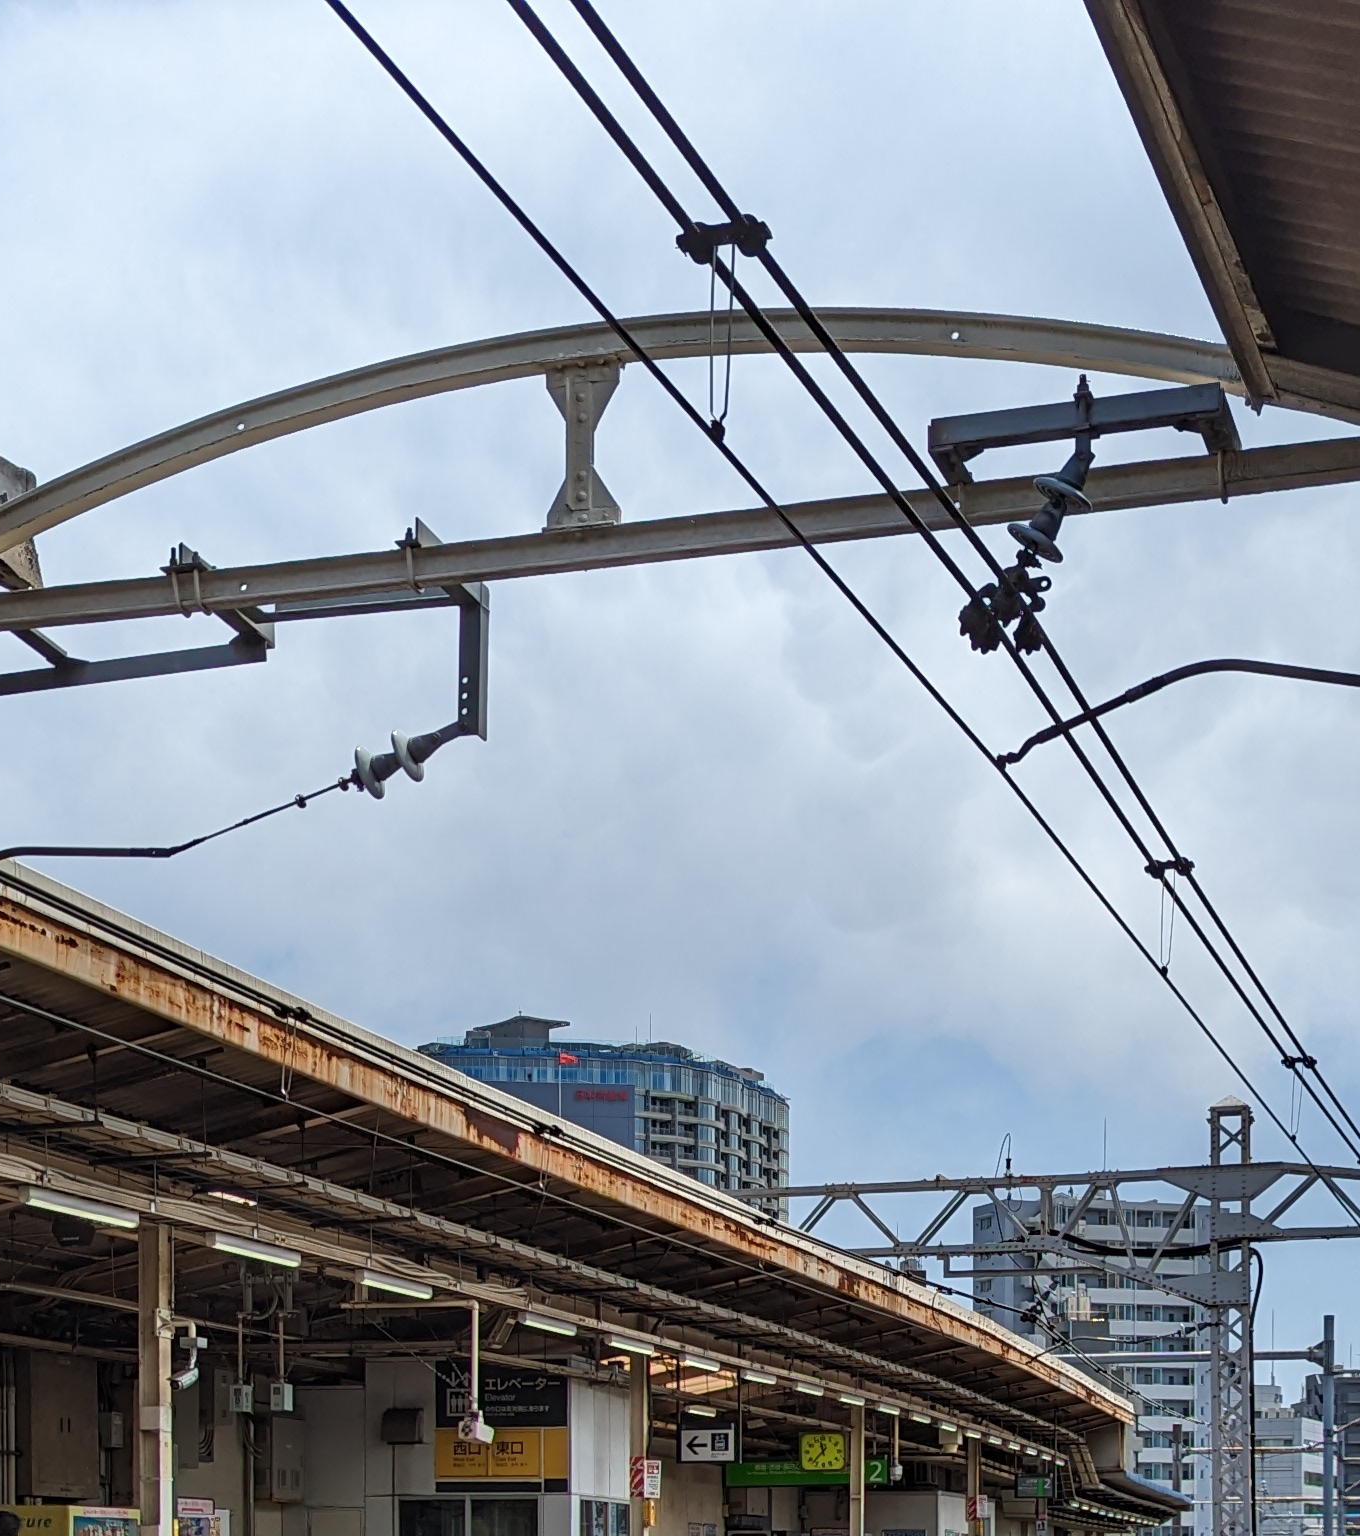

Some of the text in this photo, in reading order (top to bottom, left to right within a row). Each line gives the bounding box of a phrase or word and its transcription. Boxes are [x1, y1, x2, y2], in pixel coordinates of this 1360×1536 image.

[484, 1377, 560, 1391] エレベーター
[484, 1393, 517, 1402] Elevator
[453, 1441, 524, 1456] 西口 東口
[869, 1461, 883, 1482] 2
[1043, 1478, 1052, 1489] 2
